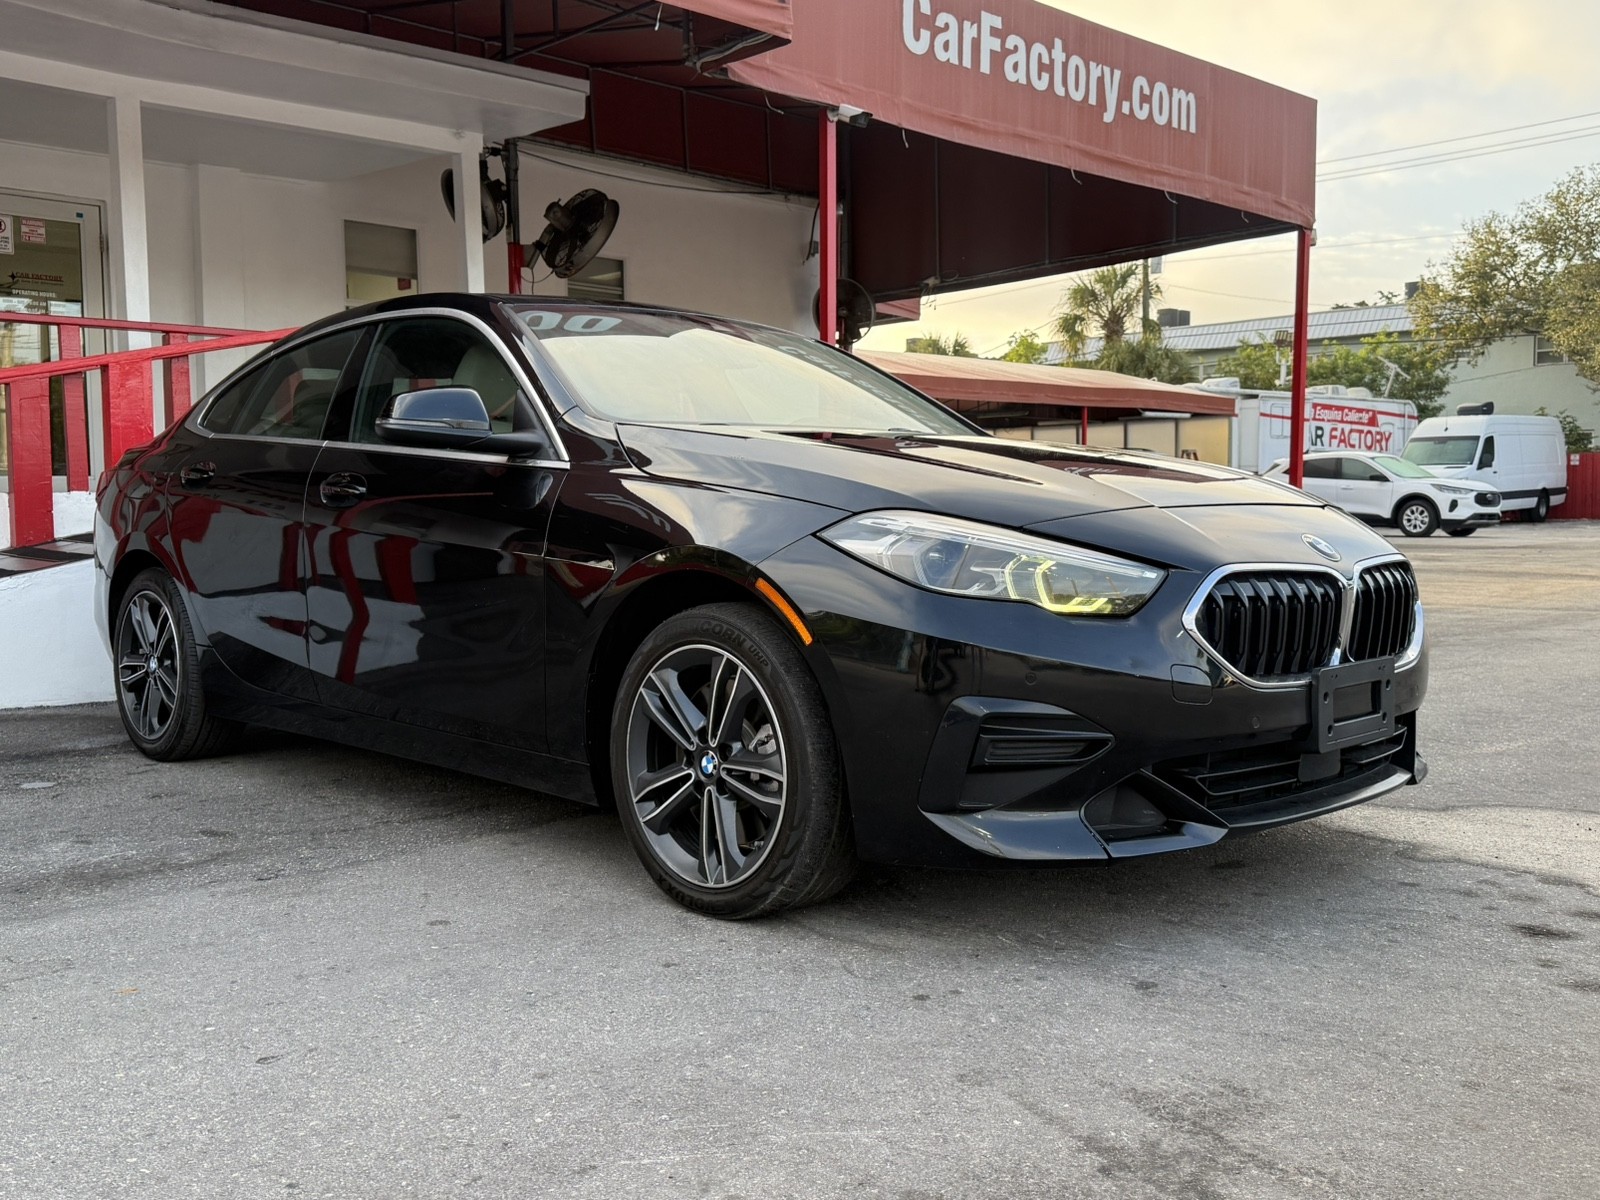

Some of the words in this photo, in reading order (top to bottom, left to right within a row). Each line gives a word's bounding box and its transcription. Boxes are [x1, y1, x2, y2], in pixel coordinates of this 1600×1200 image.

[902, 0, 1196, 134] CarFactory.com
[31, 273, 63, 281] FACTORY
[12, 289, 39, 297] OPERATING
[1315, 406, 1341, 422] Esquina
[1328, 426, 1393, 452] FACTORY
